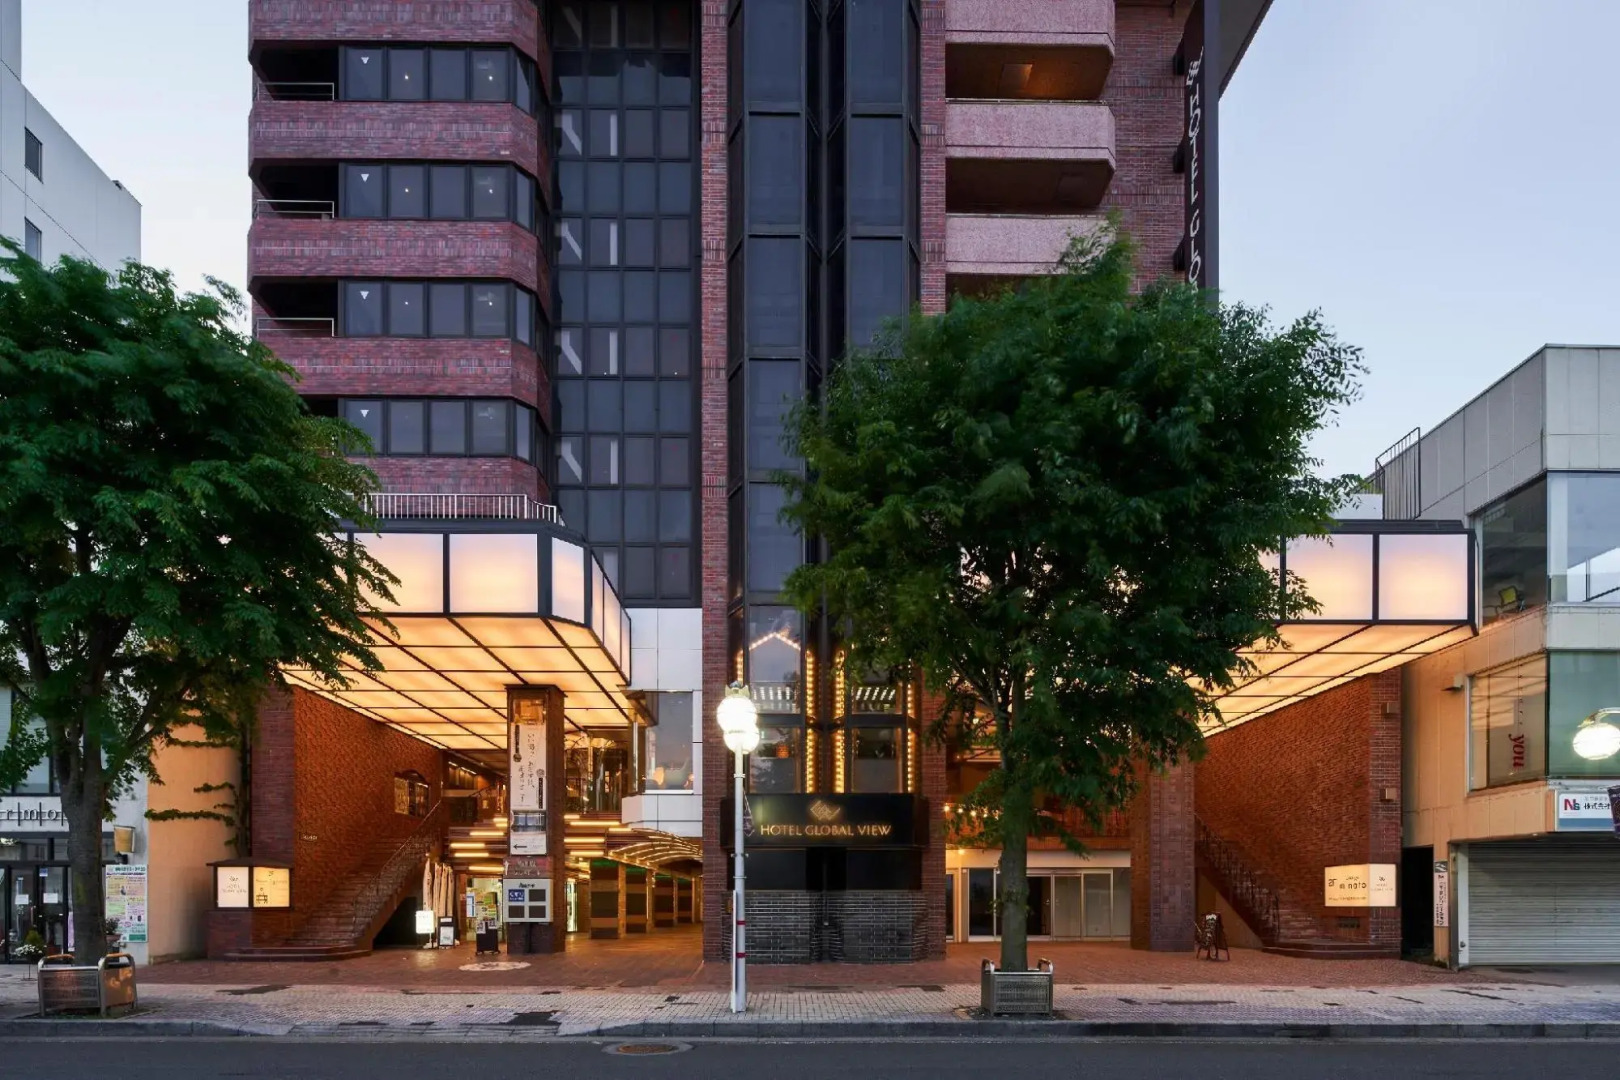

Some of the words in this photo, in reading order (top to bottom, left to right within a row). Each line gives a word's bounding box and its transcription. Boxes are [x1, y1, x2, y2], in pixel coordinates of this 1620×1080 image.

[1188, 83, 1201, 205] HOTEL
[760, 824, 803, 836] HOTEL
[804, 824, 855, 836] GLOBAL
[857, 824, 892, 836] VIEW
